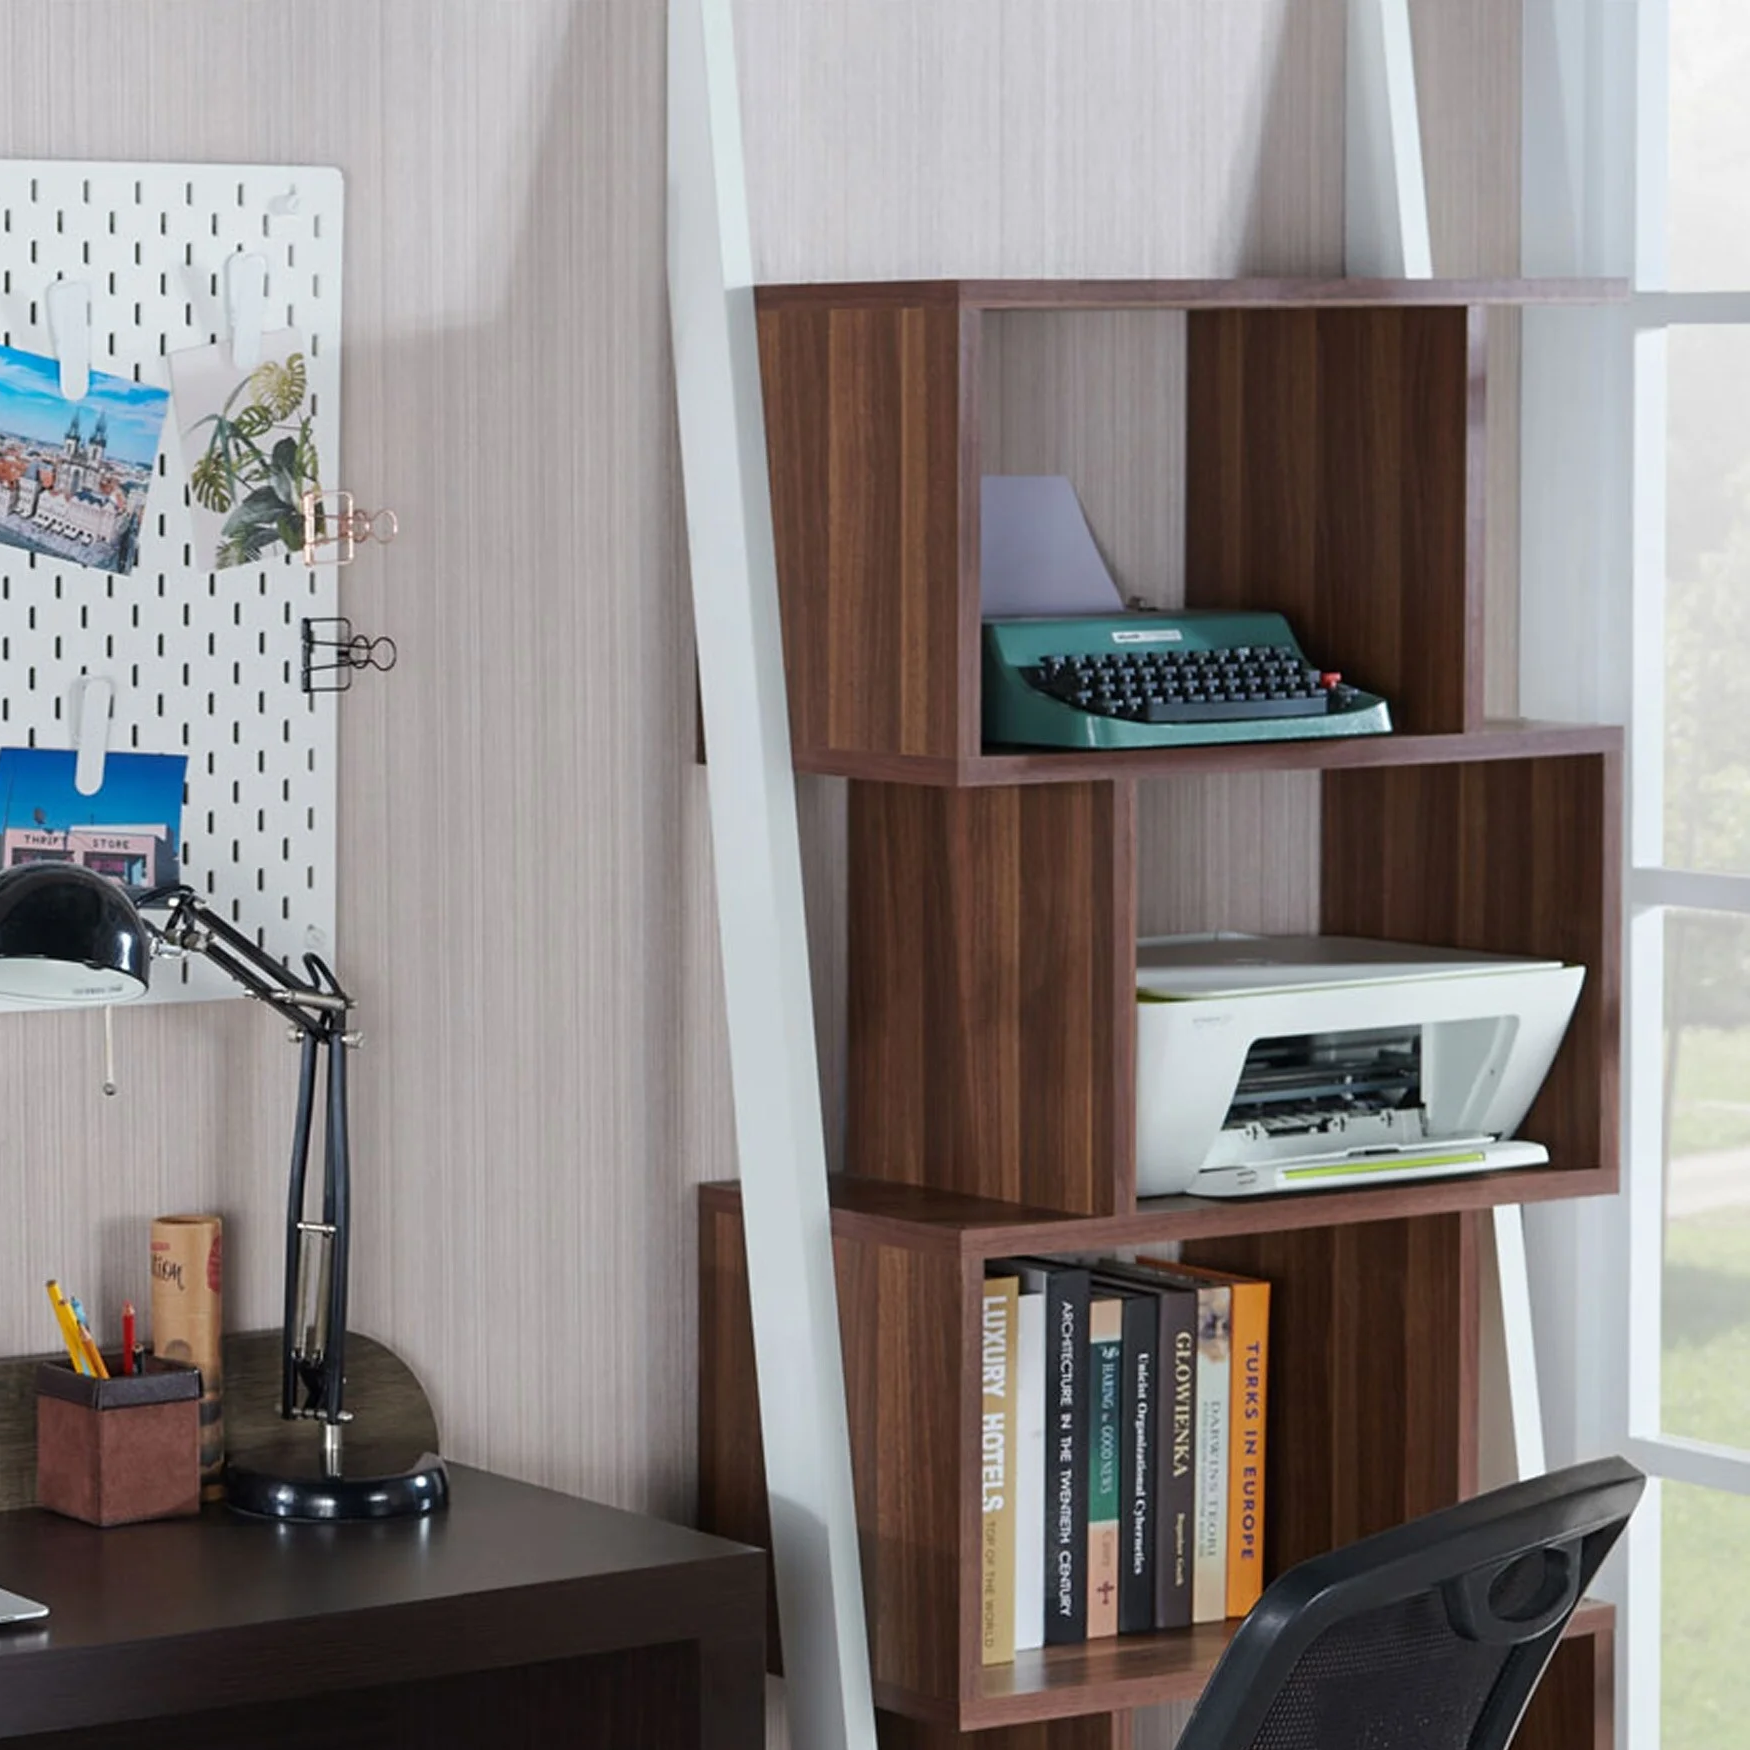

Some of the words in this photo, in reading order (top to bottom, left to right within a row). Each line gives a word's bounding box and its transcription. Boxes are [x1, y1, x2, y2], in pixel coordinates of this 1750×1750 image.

[93, 838, 130, 850] STORE
[982, 1295, 1008, 1397] LUXURY
[1060, 1301, 1074, 1406] ARCHITECTURE
[1136, 1352, 1149, 1399] Unicist
[1245, 1341, 1260, 1420] TURKS
[1061, 1413, 1072, 1429] IN
[1100, 1425, 1114, 1458] GOOD
[1244, 1430, 1258, 1455] IN
[982, 1413, 1005, 1513] HOTELS
[1060, 1438, 1072, 1462] THE
[1134, 1402, 1148, 1497] Organizational
[1059, 1469, 1072, 1543] TWENTIETH
[1241, 1467, 1256, 1561] EUROPE
[985, 1520, 996, 1545] TOP
[1132, 1499, 1146, 1575] Cybernetics
[985, 1549, 996, 1566] OF
[985, 1571, 996, 1596] THE
[1058, 1551, 1072, 1617] CENTURY
[984, 1601, 995, 1648] WORLD
